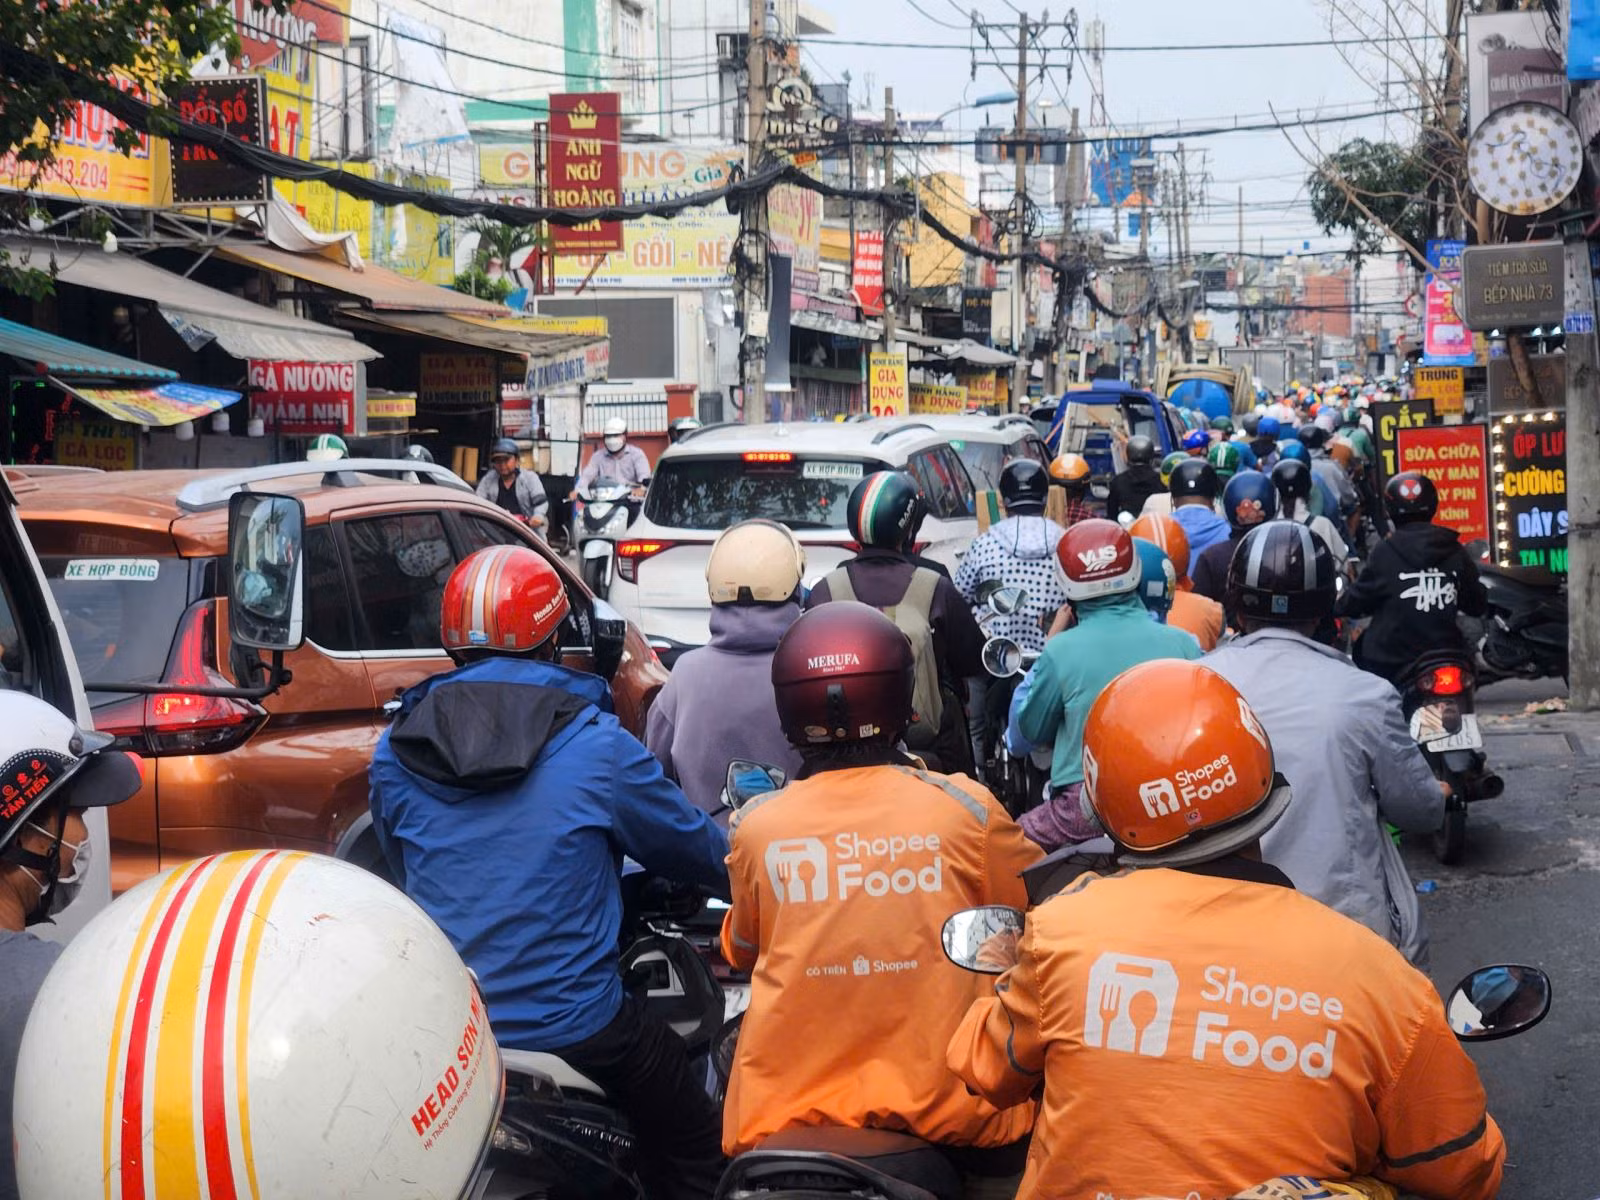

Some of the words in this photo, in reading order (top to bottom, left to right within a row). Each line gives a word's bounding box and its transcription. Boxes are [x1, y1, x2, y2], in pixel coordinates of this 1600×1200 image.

[566, 138, 602, 156] ANH
[553, 184, 616, 207] HOÀNG
[1484, 281, 1508, 304] BẾP
[1511, 282, 1536, 302] NHÀ
[1540, 284, 1553, 300] 73
[252, 363, 279, 392] GÀ
[284, 362, 354, 392] NƯỚNG
[878, 368, 897, 382] GIA
[1420, 368, 1459, 382] TRUNG
[872, 387, 904, 402] DỤNG
[1438, 442, 1480, 460] CHỮA
[1513, 424, 1537, 459] ỐP
[1542, 429, 1567, 457] LƯ
[1448, 463, 1479, 480] MÀN
[1504, 464, 1565, 497] CƯỜNG
[1453, 487, 1477, 500] PIN
[1517, 506, 1553, 539] DÂY
[1557, 509, 1568, 535] S
[67, 564, 85, 576] XE
[88, 562, 115, 578] HỢP
[119, 558, 157, 577] ĐỒNG
[1519, 549, 1545, 567] TAI
[1550, 548, 1569, 573] N
[808, 653, 860, 670] MERUFA
[1175, 754, 1230, 787] Shopee
[1180, 765, 1237, 808] Food
[835, 831, 941, 863] Shopee
[837, 856, 942, 900] Food
[873, 959, 919, 974] Shopee
[1201, 964, 1344, 1021] Shopee
[1192, 1011, 1337, 1079] Food
[411, 1065, 460, 1137] HEAD
